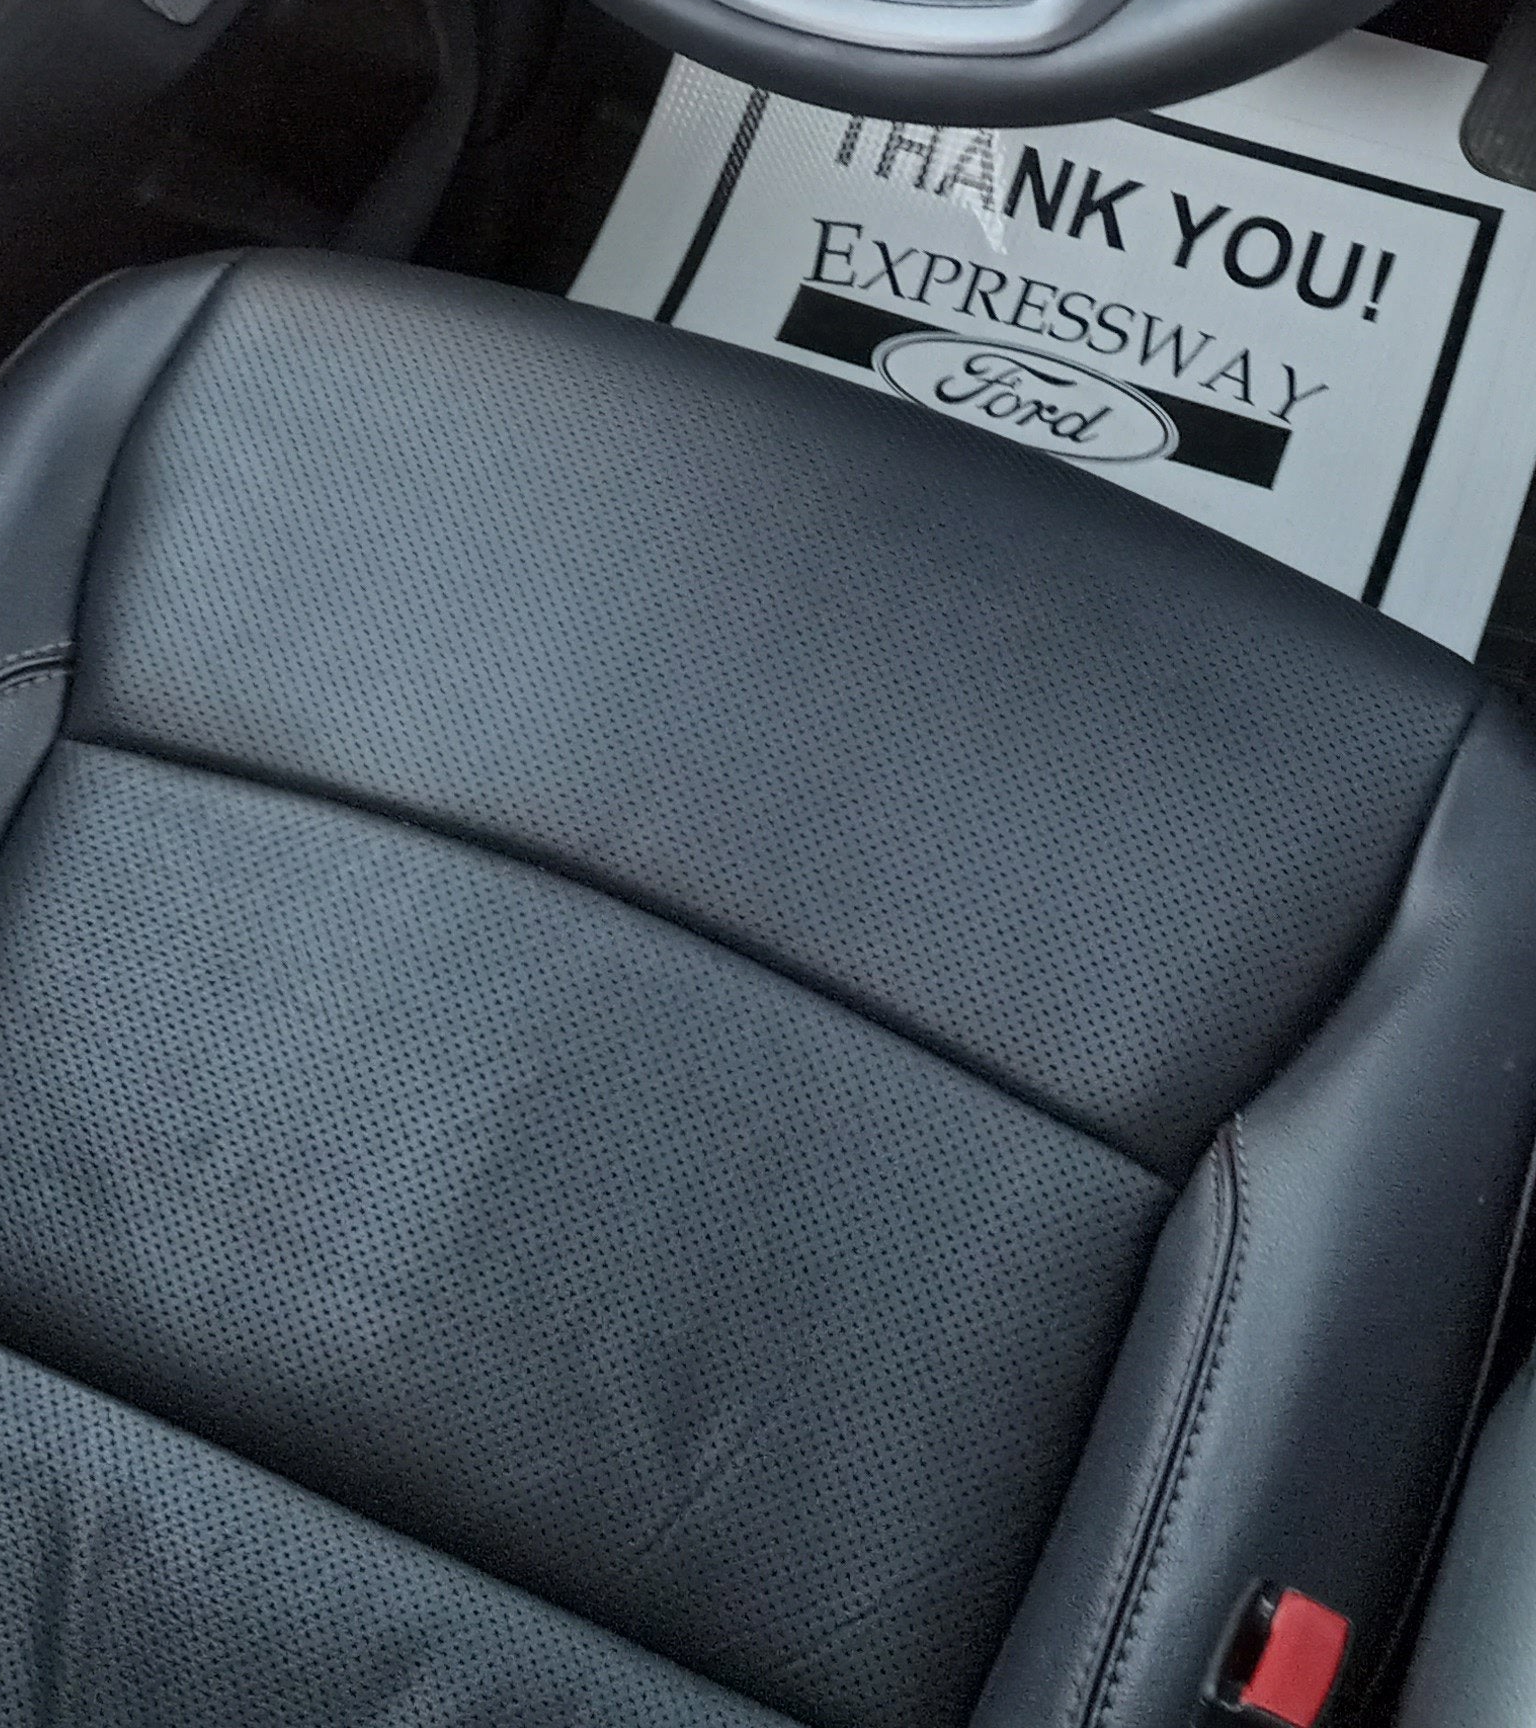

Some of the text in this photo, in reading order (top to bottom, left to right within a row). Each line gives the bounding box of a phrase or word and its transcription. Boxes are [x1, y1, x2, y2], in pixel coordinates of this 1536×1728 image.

[803, 217, 1330, 425] EXPRESSWAY
[1170, 189, 1397, 324] YOU!
[933, 353, 1113, 443] Ford
